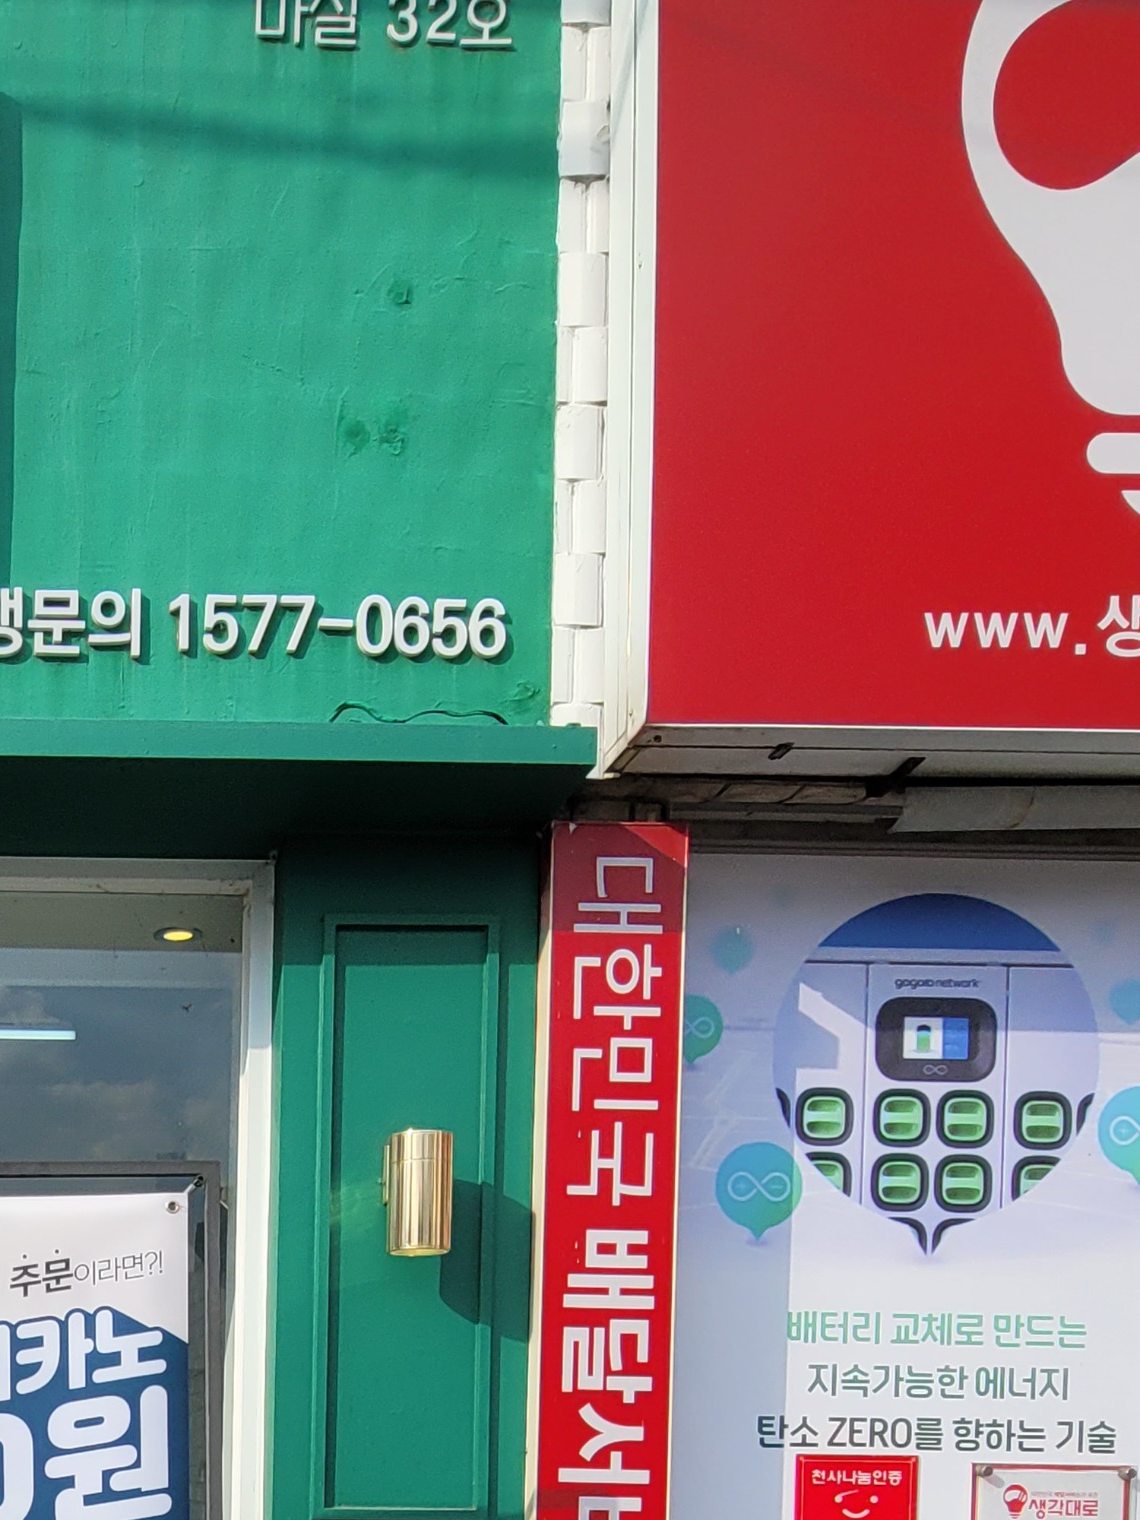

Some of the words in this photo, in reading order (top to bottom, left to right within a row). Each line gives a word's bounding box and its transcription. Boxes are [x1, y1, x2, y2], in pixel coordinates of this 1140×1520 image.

[255, 0, 357, 47] 마실
[169, 593, 507, 660] 1577-0656
[566, 857, 663, 1207] 대한민국
[9, 1250, 165, 1299] 주문이라면?!
[787, 1311, 881, 1345] 배터리
[890, 1313, 984, 1346] 교체로
[993, 1314, 1087, 1349] 만드는
[807, 1363, 968, 1399] 지속가능한
[975, 1366, 1069, 1401] 에너지
[757, 1415, 820, 1449] 탄소
[827, 1416, 943, 1451] ZERO를
[952, 1418, 1046, 1452] 향하는
[1055, 1420, 1117, 1455] 기술
[811, 1469, 903, 1486] 천사나눔인증
[1028, 1499, 1099, 1520] 생각대로
